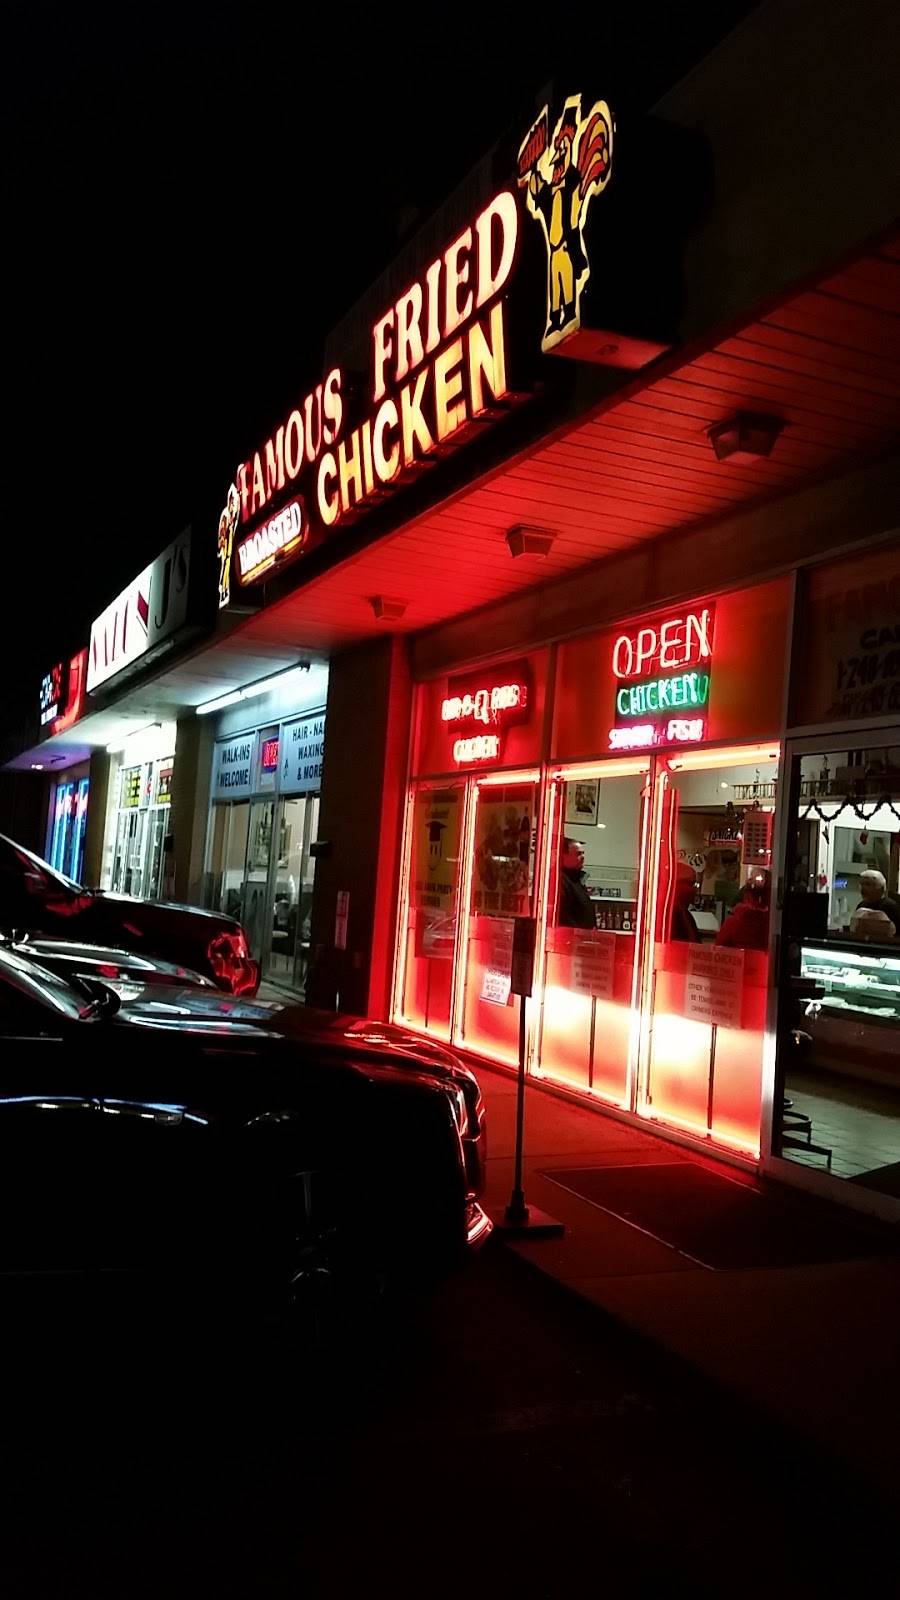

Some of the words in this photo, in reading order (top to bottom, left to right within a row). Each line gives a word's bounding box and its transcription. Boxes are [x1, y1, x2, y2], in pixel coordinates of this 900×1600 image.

[238, 367, 342, 522] FAMOUS
[373, 191, 518, 402] FRIED
[317, 301, 507, 526] CHICKEN
[612, 609, 710, 678] OPEN
[617, 672, 698, 716] CHICKEN
[222, 744, 251, 764] WALK-INS
[292, 725, 309, 742] HAIR
[304, 764, 322, 780] MORE
